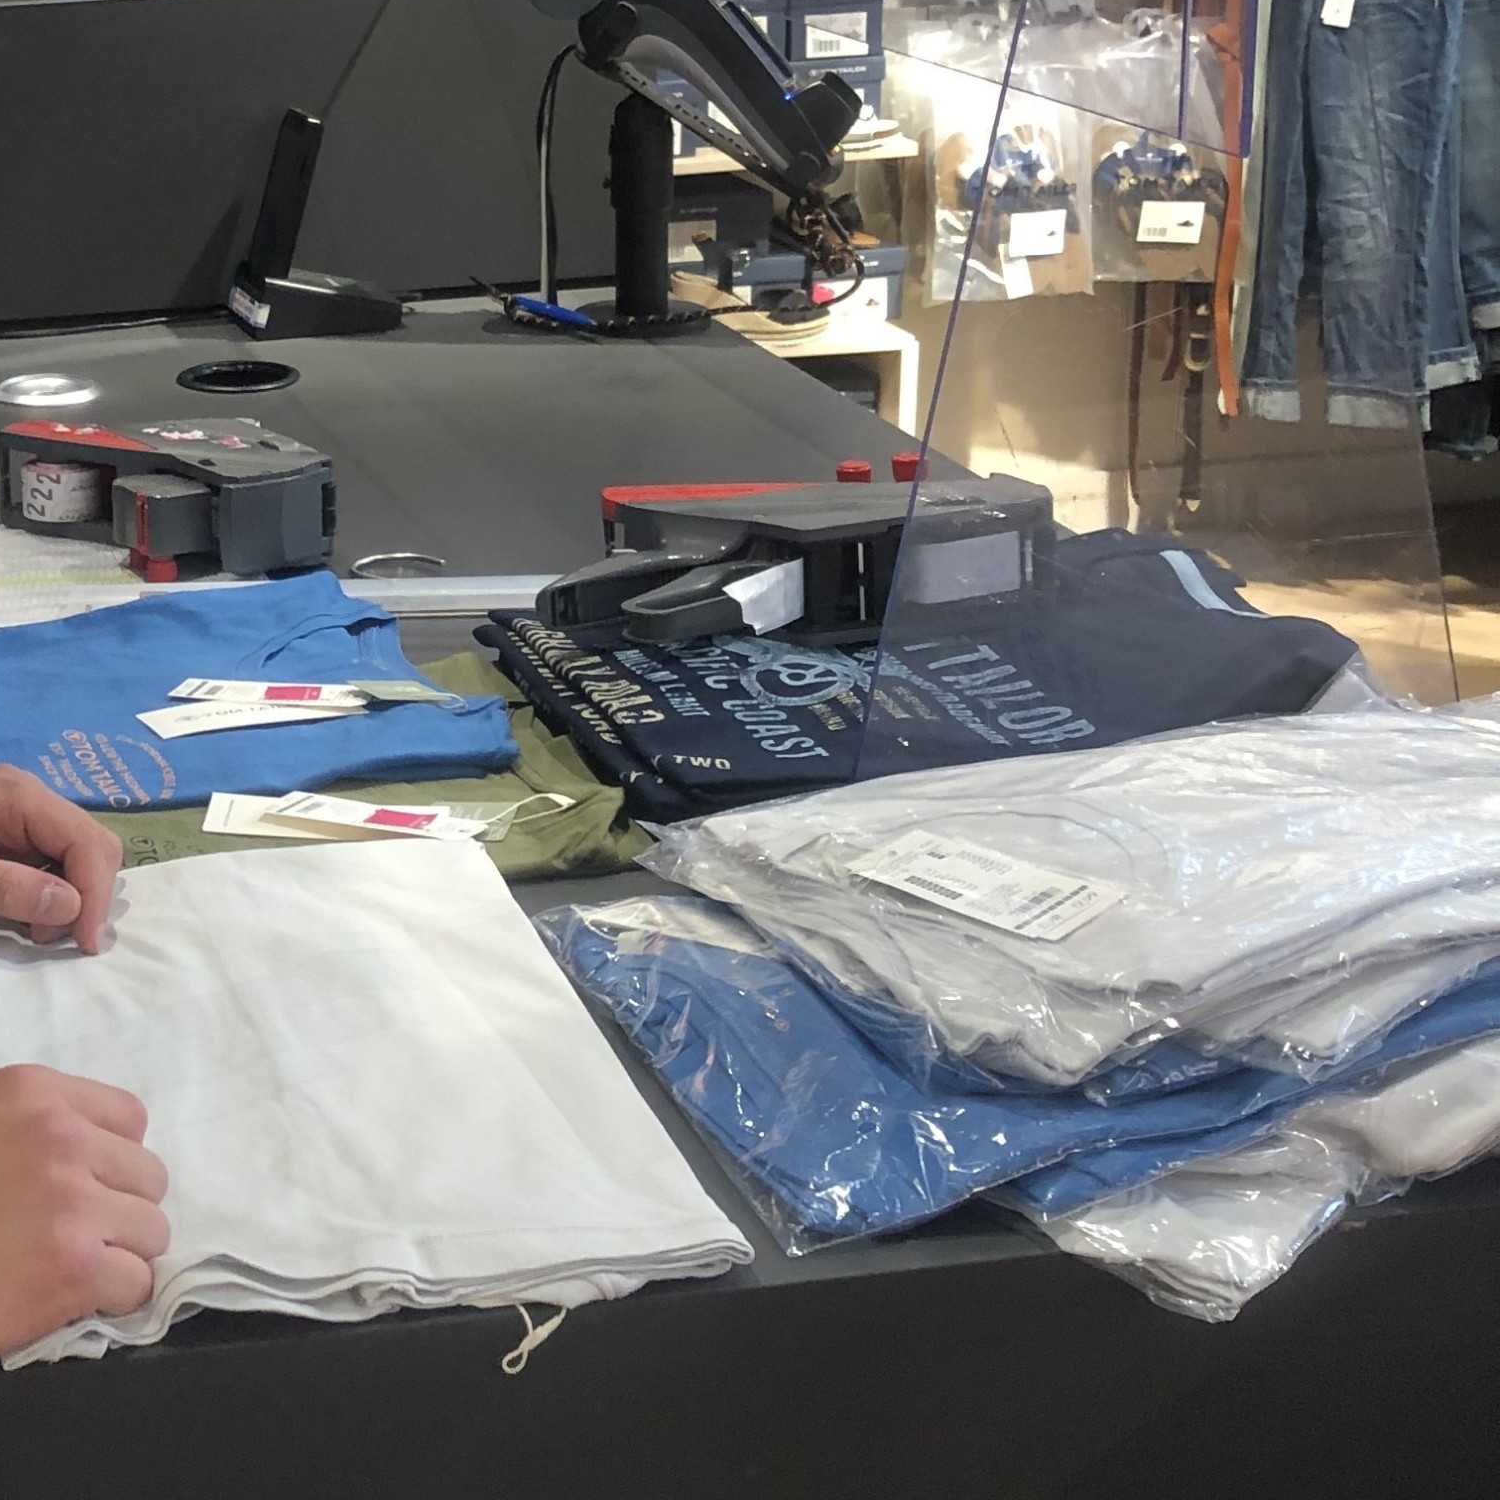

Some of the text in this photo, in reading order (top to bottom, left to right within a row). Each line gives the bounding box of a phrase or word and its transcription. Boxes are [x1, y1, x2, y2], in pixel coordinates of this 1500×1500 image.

[580, 678, 665, 724] ROAD
[926, 644, 1096, 745] TAILOR
[722, 699, 830, 759] COAST
[672, 754, 732, 771] TWO
